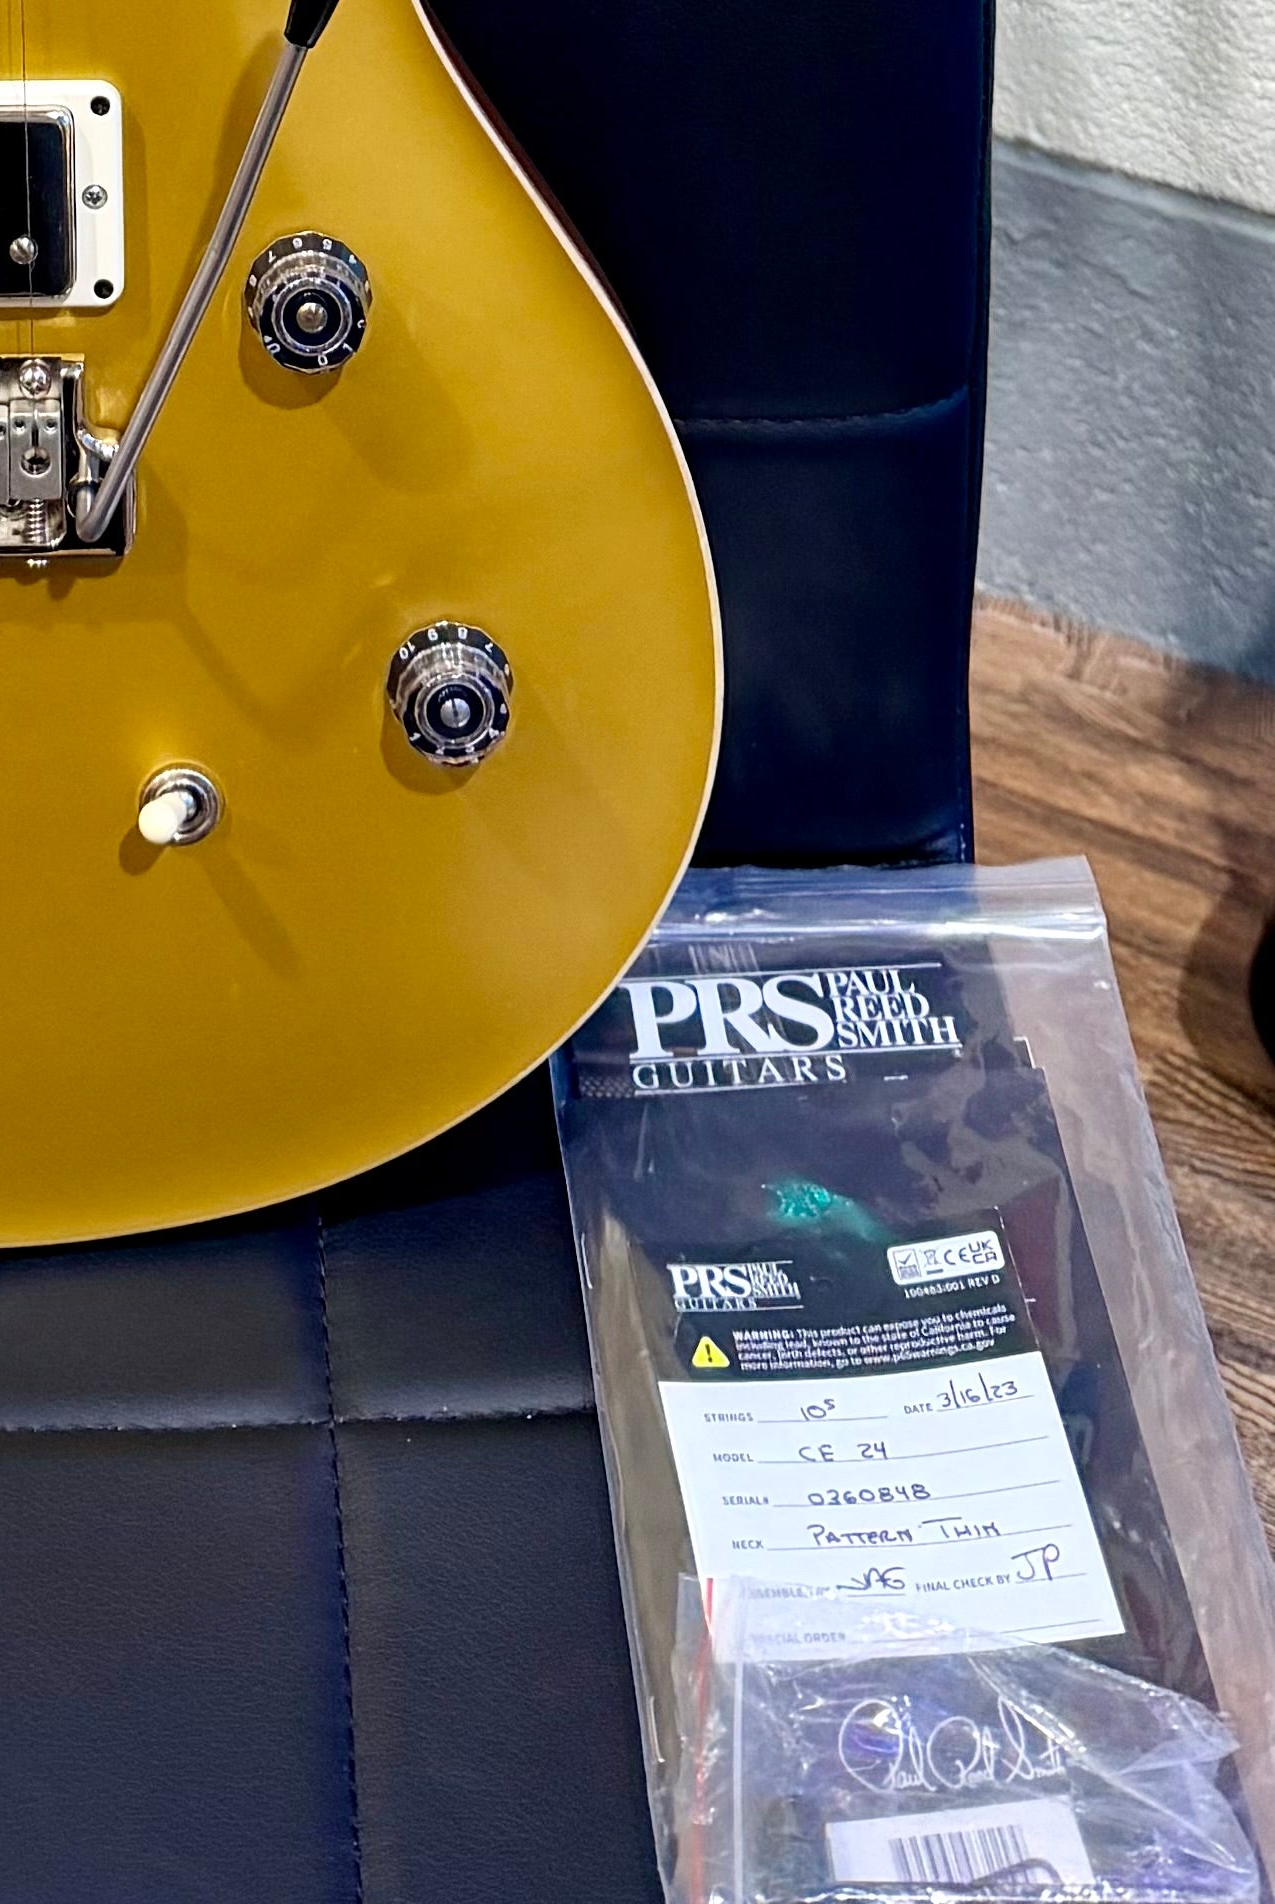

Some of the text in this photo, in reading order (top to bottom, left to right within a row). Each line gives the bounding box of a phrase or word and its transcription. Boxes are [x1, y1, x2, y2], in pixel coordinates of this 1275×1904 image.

[620, 969, 915, 1060] PRS PAUL
[832, 992, 931, 1023] REED
[836, 1016, 962, 1049] SMITH
[632, 1055, 847, 1089] GUITARS
[669, 1265, 753, 1298] PRS
[732, 1329, 794, 1341] WARNING:
[820, 1325, 860, 1339] product
[863, 1323, 882, 1334] can
[920, 1315, 941, 1329] you
[955, 1303, 1007, 1321] chemicals
[937, 1372, 1019, 1409] 3/16/23
[704, 1412, 754, 1424] STRINGS
[903, 1402, 933, 1415] DATE
[713, 1452, 754, 1463] MODEL
[798, 1441, 890, 1463] CE 24
[732, 1539, 764, 1550] NECK
[916, 1573, 1011, 1593] FINAL CHECK BY
